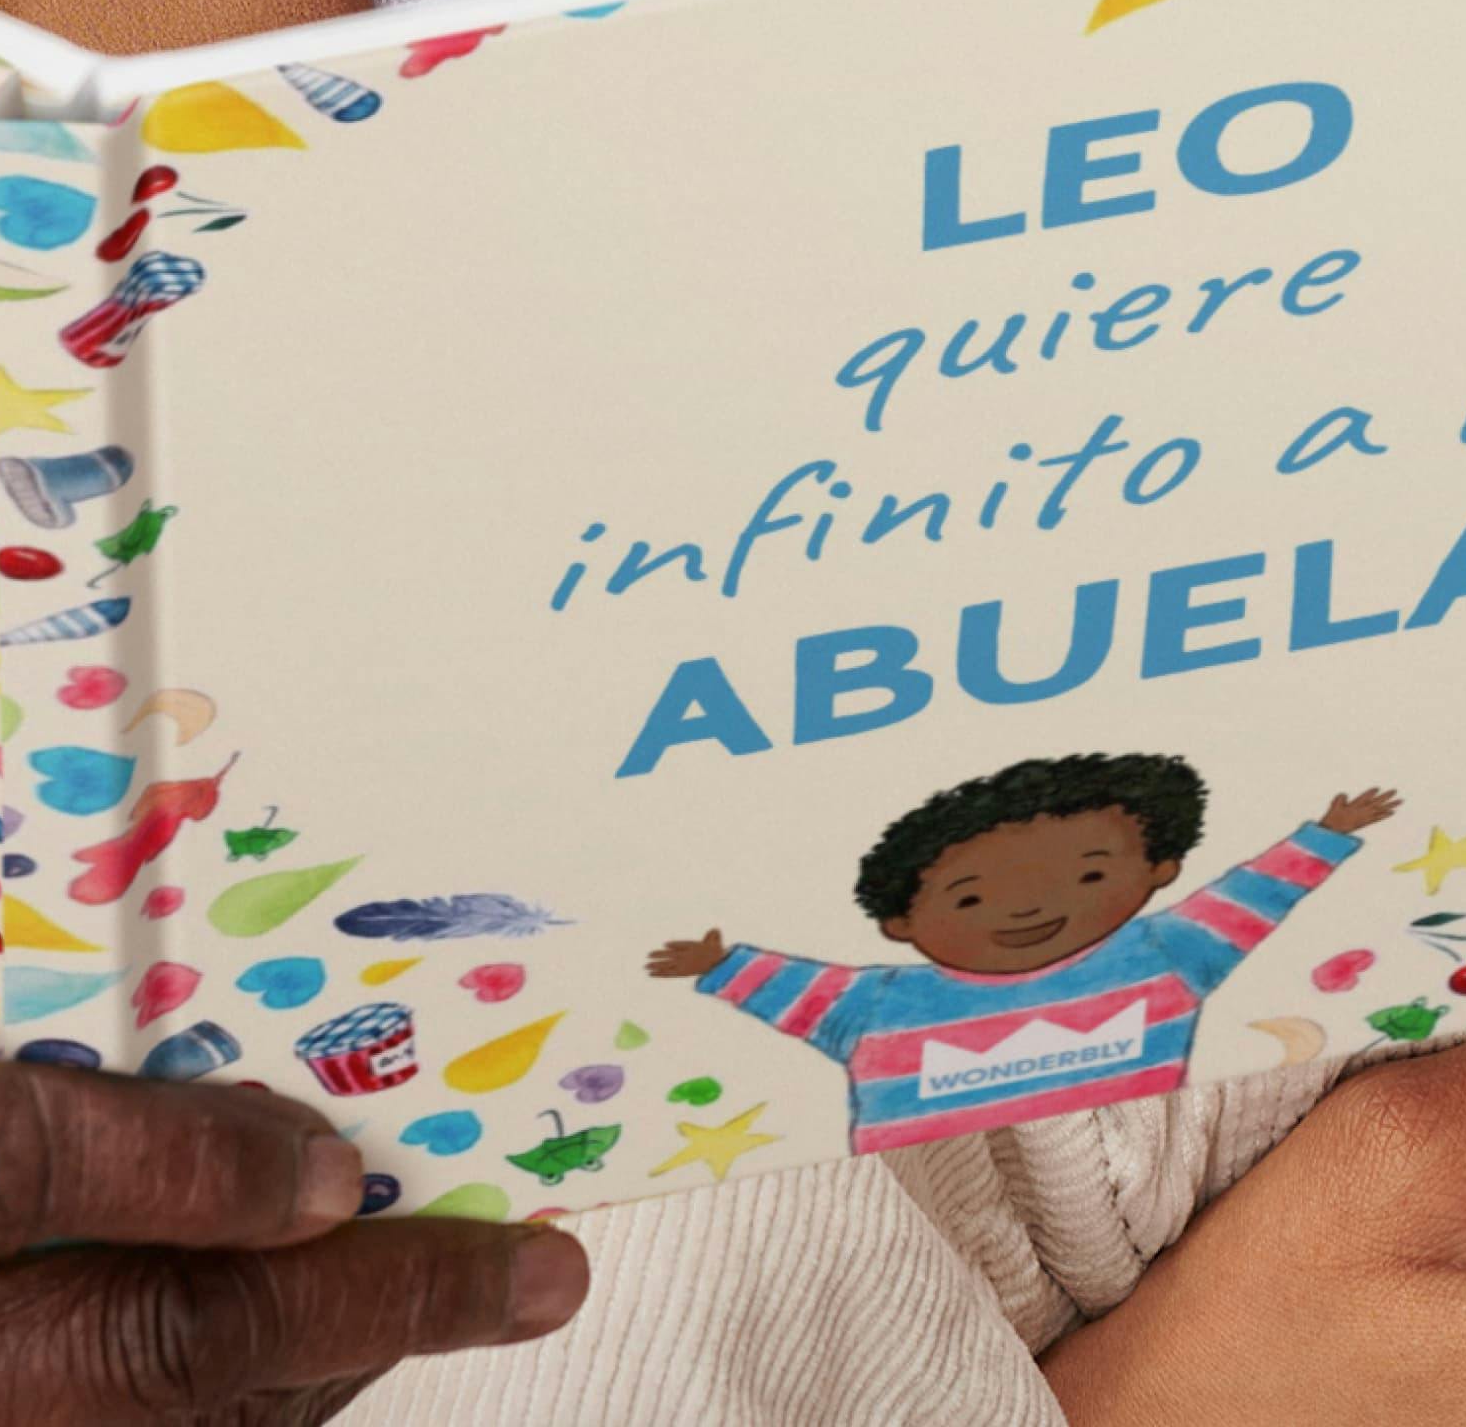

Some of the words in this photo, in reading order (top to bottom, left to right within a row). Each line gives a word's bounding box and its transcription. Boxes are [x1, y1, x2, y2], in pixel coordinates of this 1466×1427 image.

[921, 81, 1354, 252] LEO
[834, 248, 1362, 433] quiere
[549, 413, 1202, 613] infinito
[1275, 406, 1389, 475] a
[930, 1038, 1135, 1090] WONDERBLY
